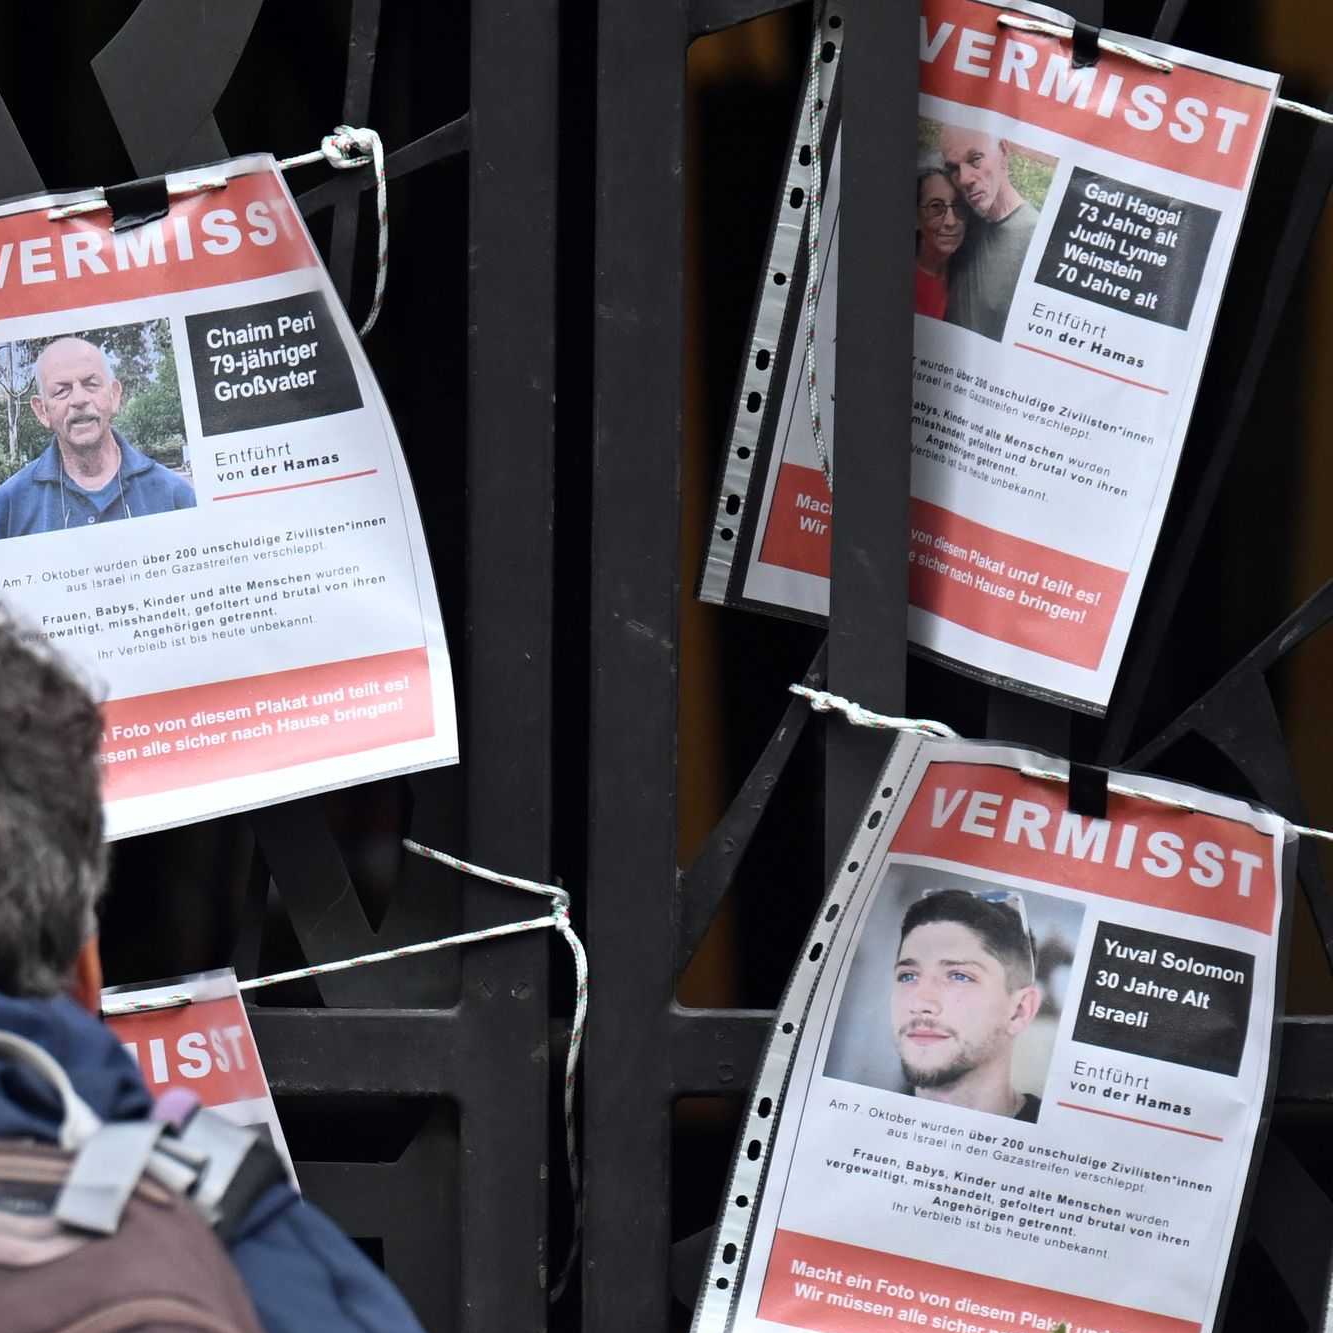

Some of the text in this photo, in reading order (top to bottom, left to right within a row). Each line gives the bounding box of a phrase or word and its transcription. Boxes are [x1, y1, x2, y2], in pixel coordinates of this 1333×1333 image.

[920, 20, 1247, 154] VERMISST
[1078, 202, 1178, 248] 73 Jahre alt
[1084, 183, 1182, 226] Gadi Haggai
[1064, 242, 1142, 282] Weinstein
[1069, 224, 1168, 267] Judih Lynne
[1056, 263, 1158, 310] 70 Jahre alt
[206, 311, 315, 349] Chaim Peri
[209, 342, 318, 376] 79-jähriger
[214, 370, 317, 401] Großvater
[215, 442, 291, 467] Entführt
[217, 454, 339, 482] von der Hamas
[800, 515, 828, 535] Wir
[142, 698, 404, 758] alle sicher nach Hause bringen!
[932, 788, 1262, 897] VERMISST
[1105, 938, 1244, 984] Yuval Solomon
[1096, 970, 1210, 1009] 30 Jahre Alt
[1088, 1000, 1149, 1028] Israeli
[123, 1026, 245, 1084] ISST
[892, 1202, 1110, 1259] Ihr Verbleib ist bis heute unbekannt.
